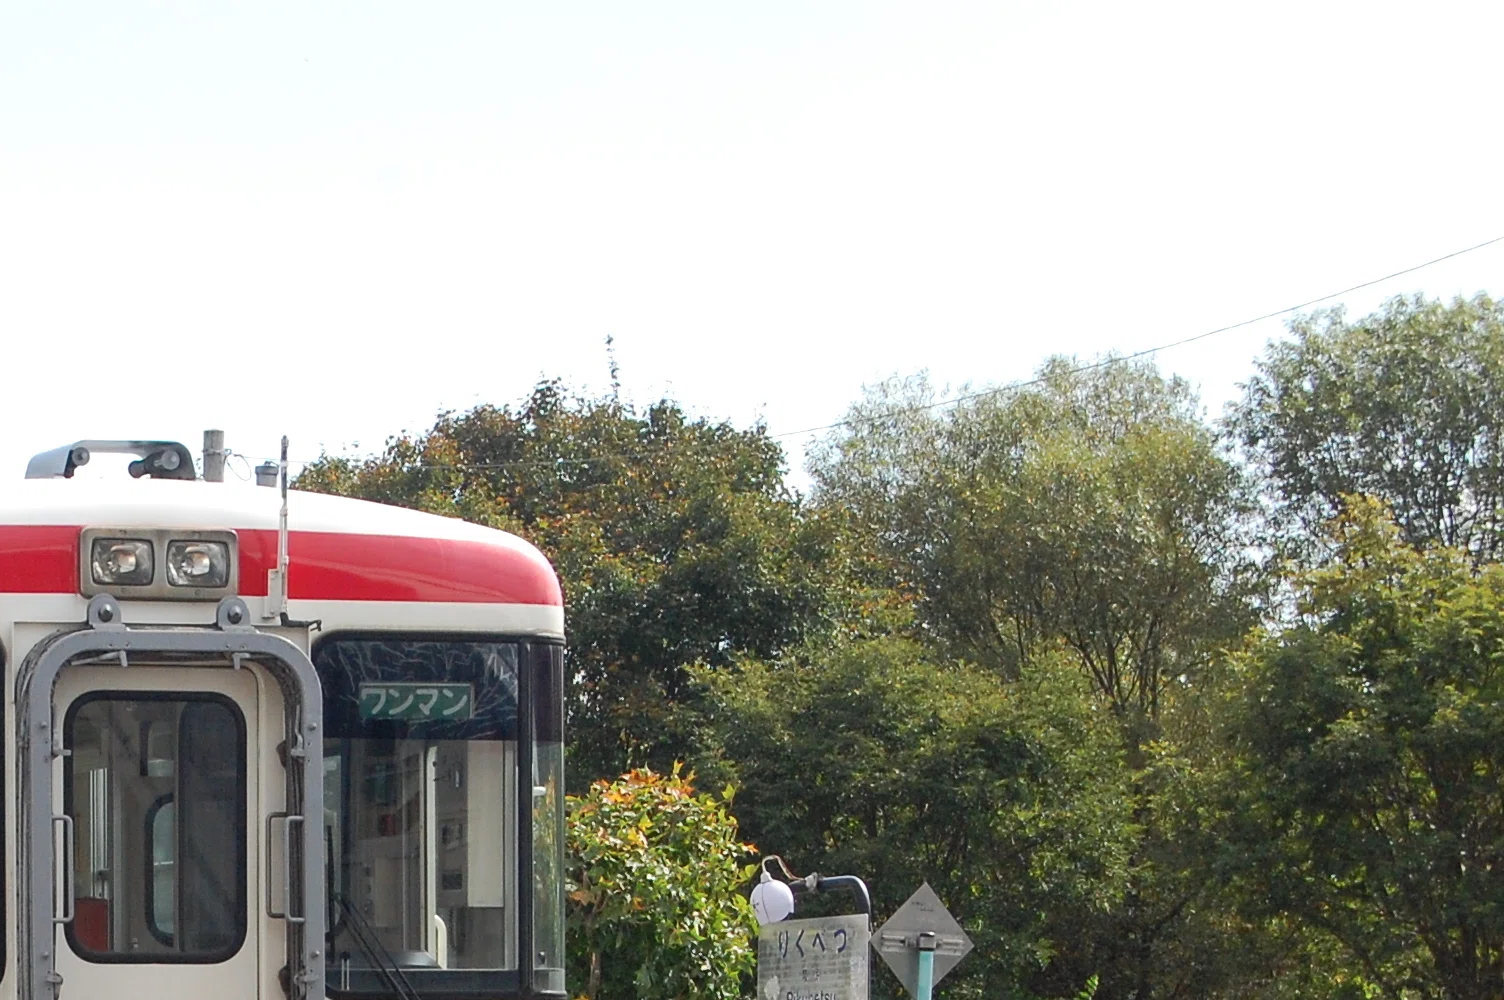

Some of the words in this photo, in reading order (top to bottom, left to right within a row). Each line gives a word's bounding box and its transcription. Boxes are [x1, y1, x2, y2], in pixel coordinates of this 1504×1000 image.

[361, 688, 469, 716] ワンマン
[778, 928, 847, 959] りくべつ
